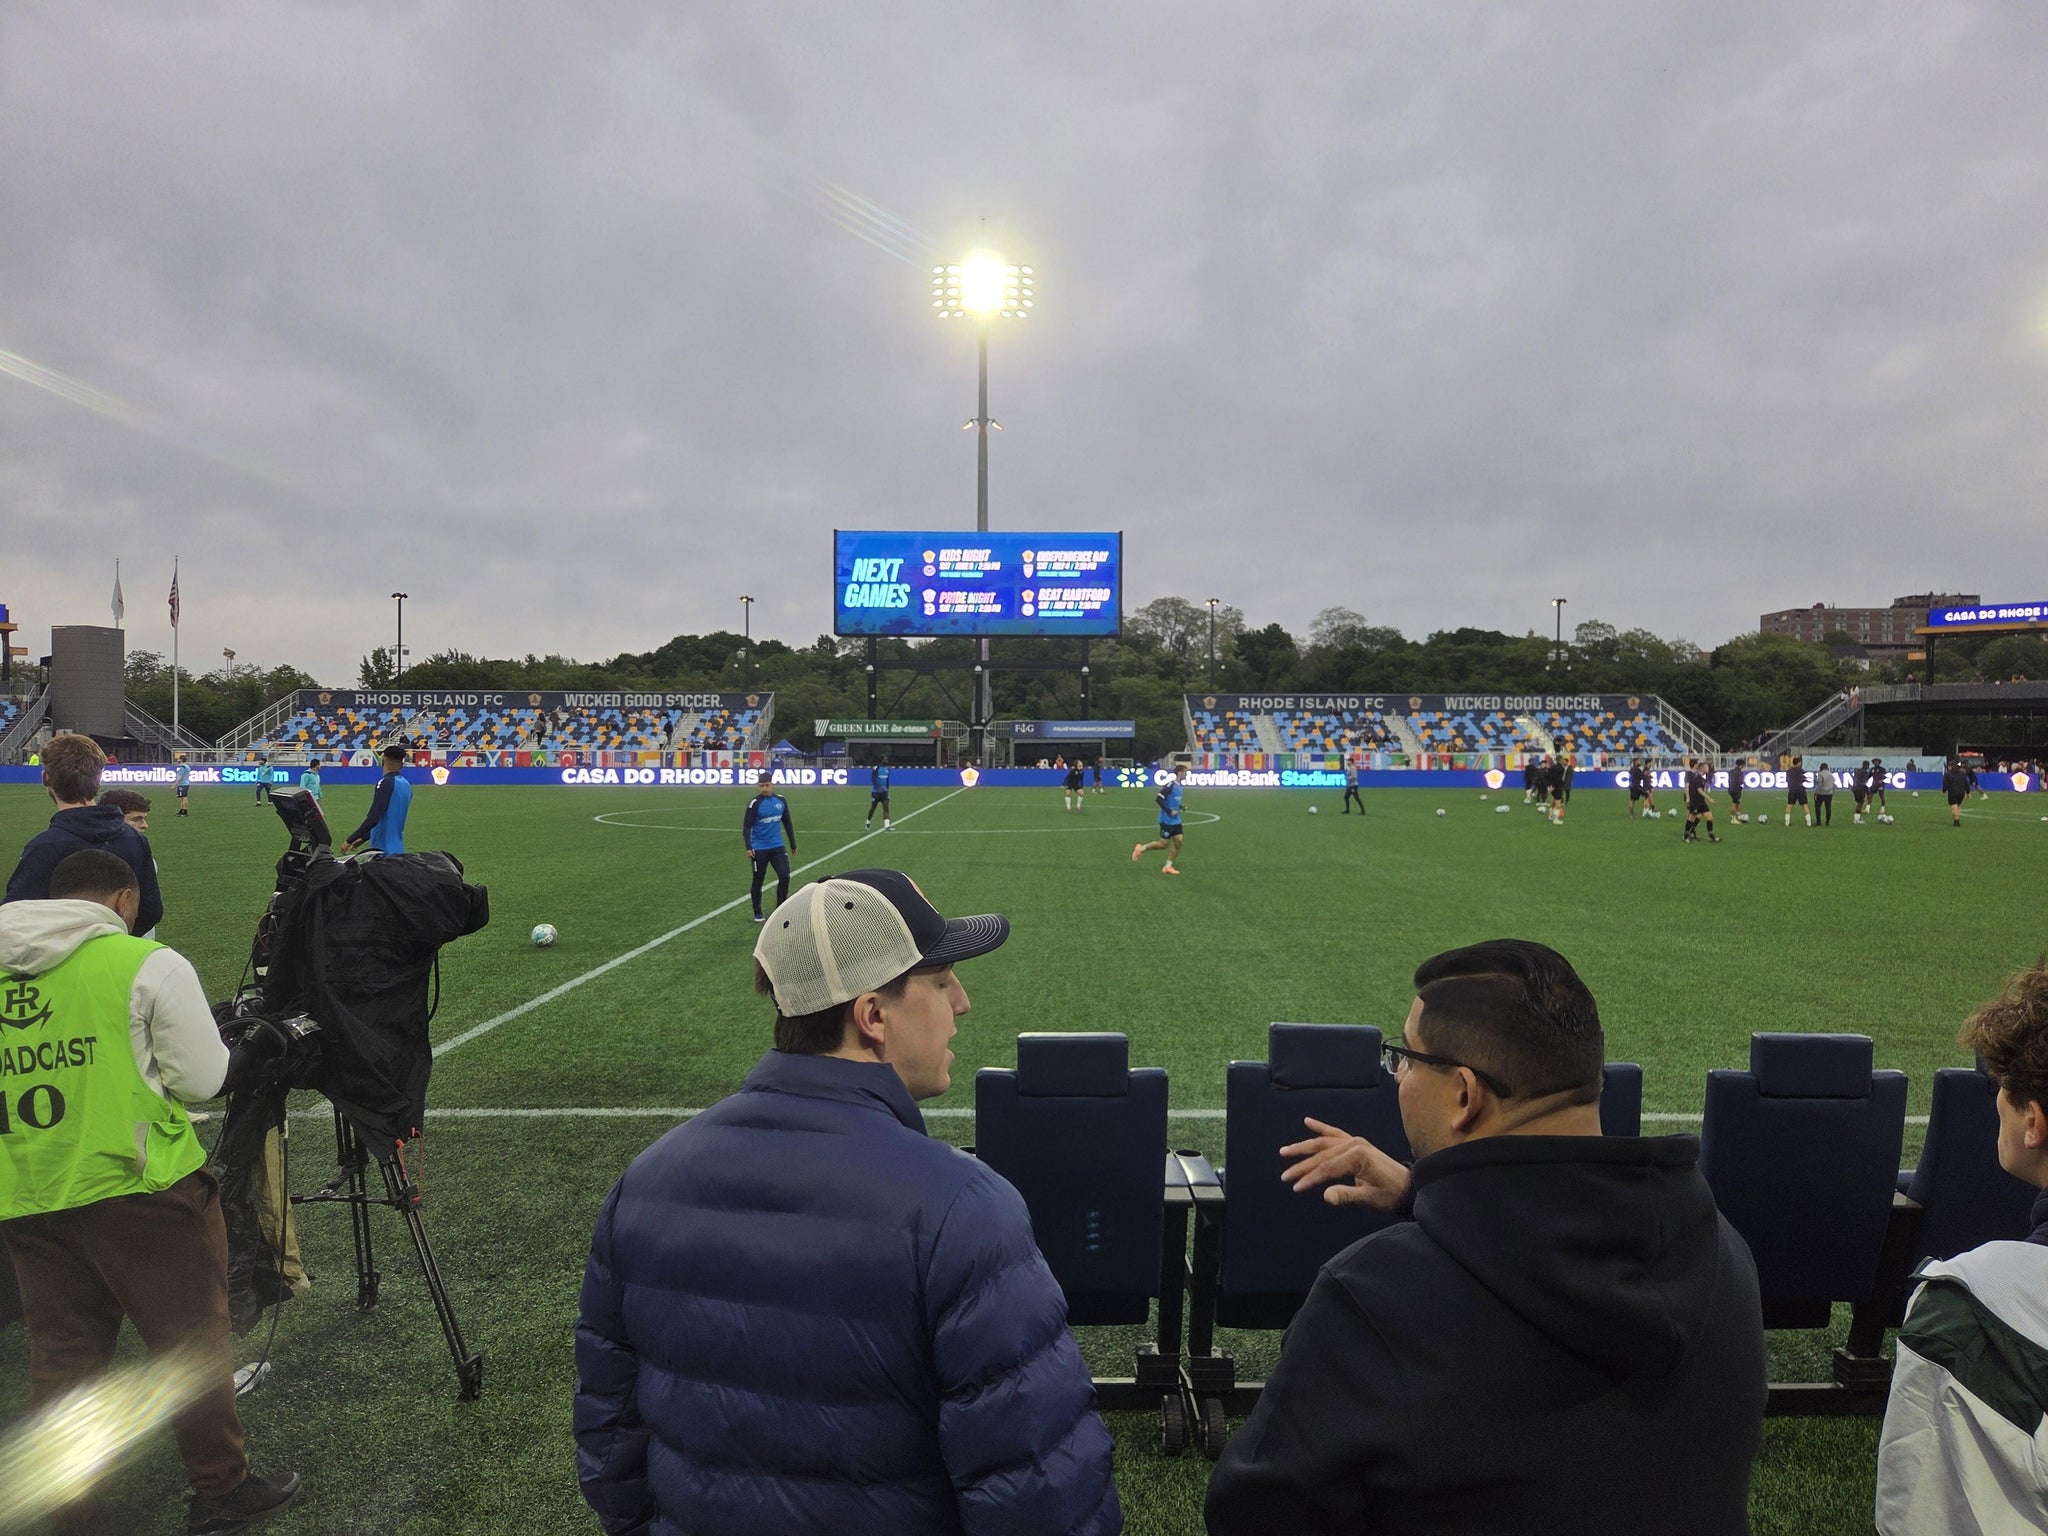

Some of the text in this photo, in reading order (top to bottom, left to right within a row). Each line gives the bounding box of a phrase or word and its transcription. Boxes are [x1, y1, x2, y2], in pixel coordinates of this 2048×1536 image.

[852, 558, 903, 583] NEXT
[844, 584, 910, 608] GAMES
[939, 591, 996, 603] PRIDE NIGHT
[1945, 611, 1976, 622] CASA
[1979, 609, 1996, 620] DO
[1999, 607, 2041, 618] RHODE
[355, 694, 503, 705] RHODE ISLAND FC
[565, 693, 724, 707] WICKED GOOD SOCCER.
[1239, 697, 1384, 709] RHODE ISLAND FC
[1445, 696, 1604, 710] WICKED GOOD SOCCER.
[829, 724, 864, 733] GREEN
[865, 724, 889, 733] LINE
[100, 767, 289, 782] entrevilleank Stadm
[561, 768, 620, 784] CASA
[624, 768, 656, 784] DO
[660, 768, 734, 784] RHODE
[821, 768, 848, 784] FC
[1154, 769, 1347, 787] CetrevilleBank Stadium
[1615, 771, 1673, 788] CA
[1714, 771, 1788, 788] RODE
[0, 1036, 97, 1077] ADCAST
